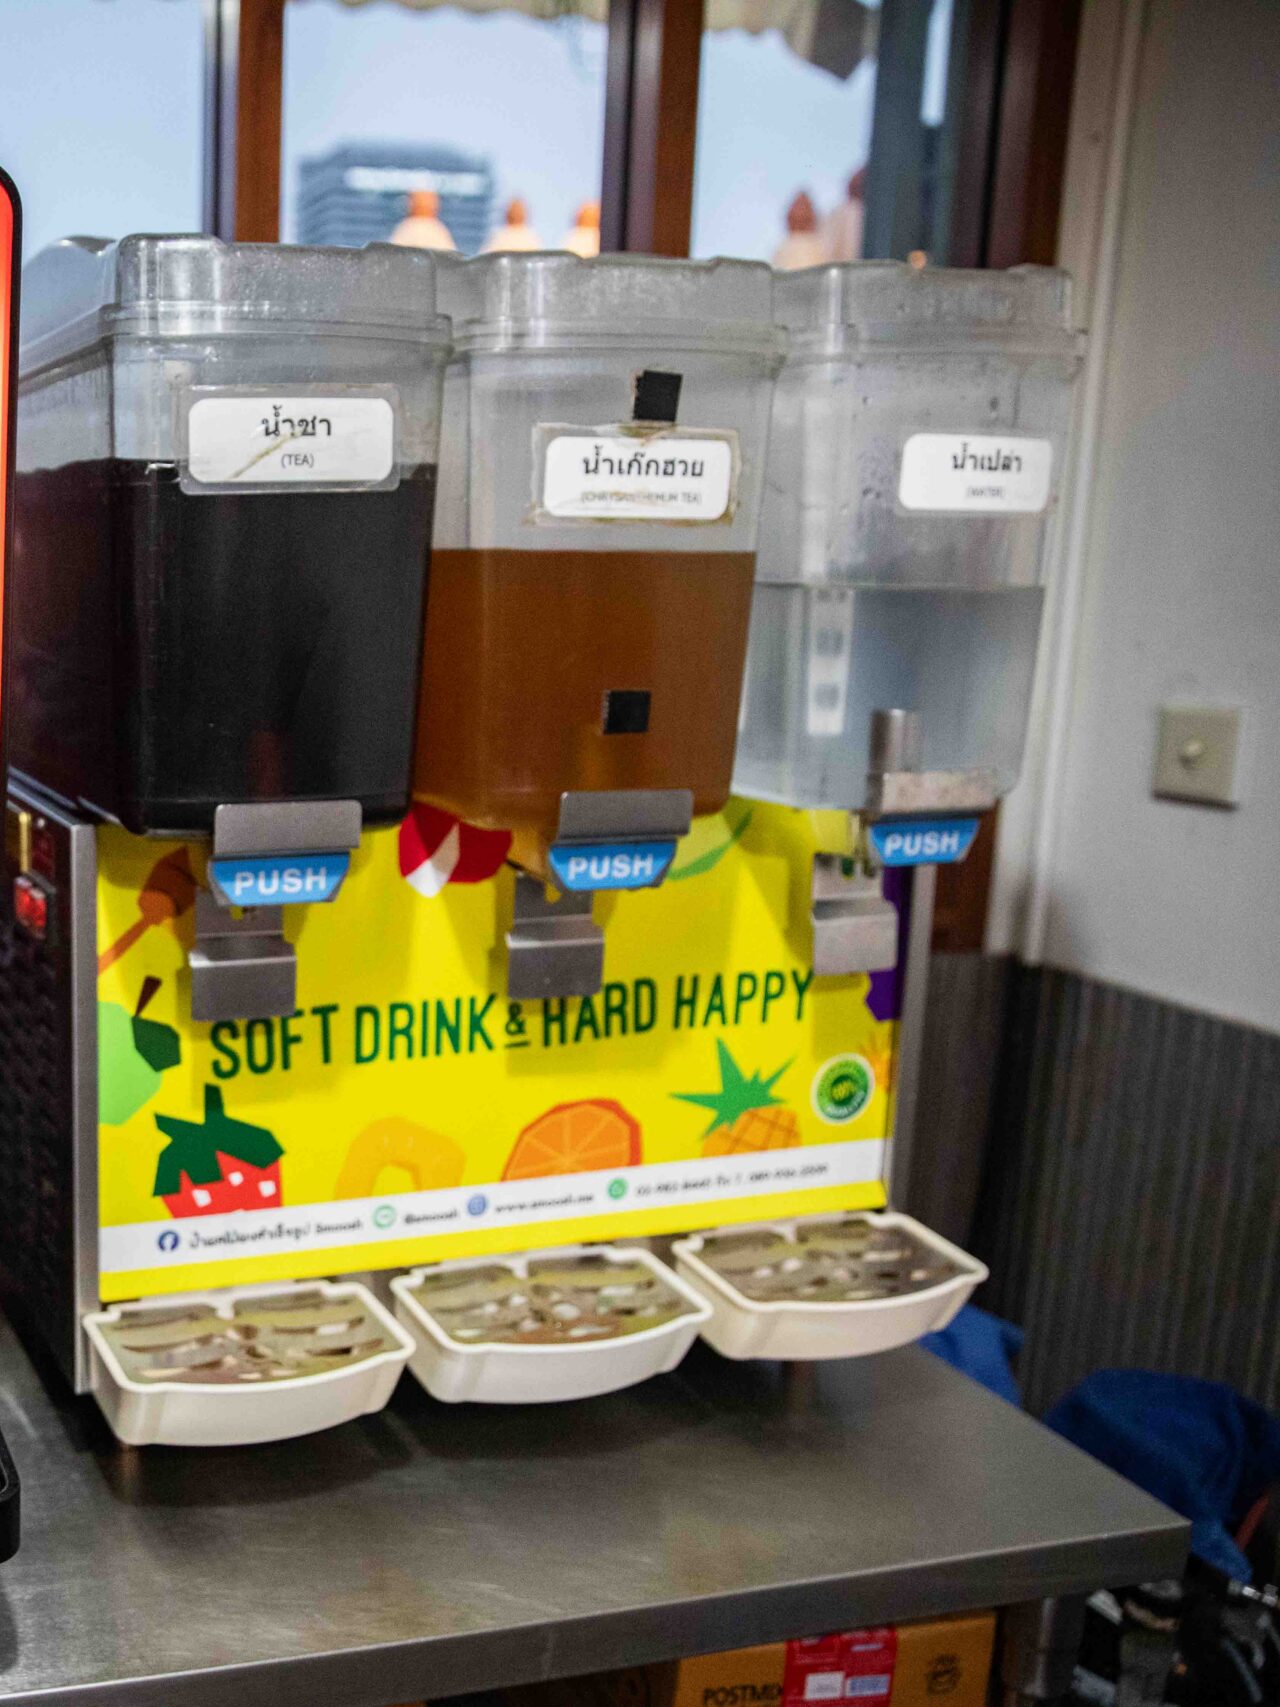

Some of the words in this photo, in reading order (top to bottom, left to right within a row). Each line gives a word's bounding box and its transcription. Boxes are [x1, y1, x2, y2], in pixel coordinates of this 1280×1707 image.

[261, 404, 332, 437] น้ำชา
[281, 454, 315, 468] (TEA)
[583, 445, 705, 477] น้ำเก๊กฮวย
[884, 830, 960, 857] PUSH
[234, 867, 327, 896] PUSH
[568, 854, 654, 880] PUSH
[210, 1004, 339, 1079] SOFT
[354, 992, 497, 1064] DRINK
[504, 1001, 528, 1042] &
[542, 978, 658, 1048] HARD
[673, 966, 815, 1030] HAPPY
